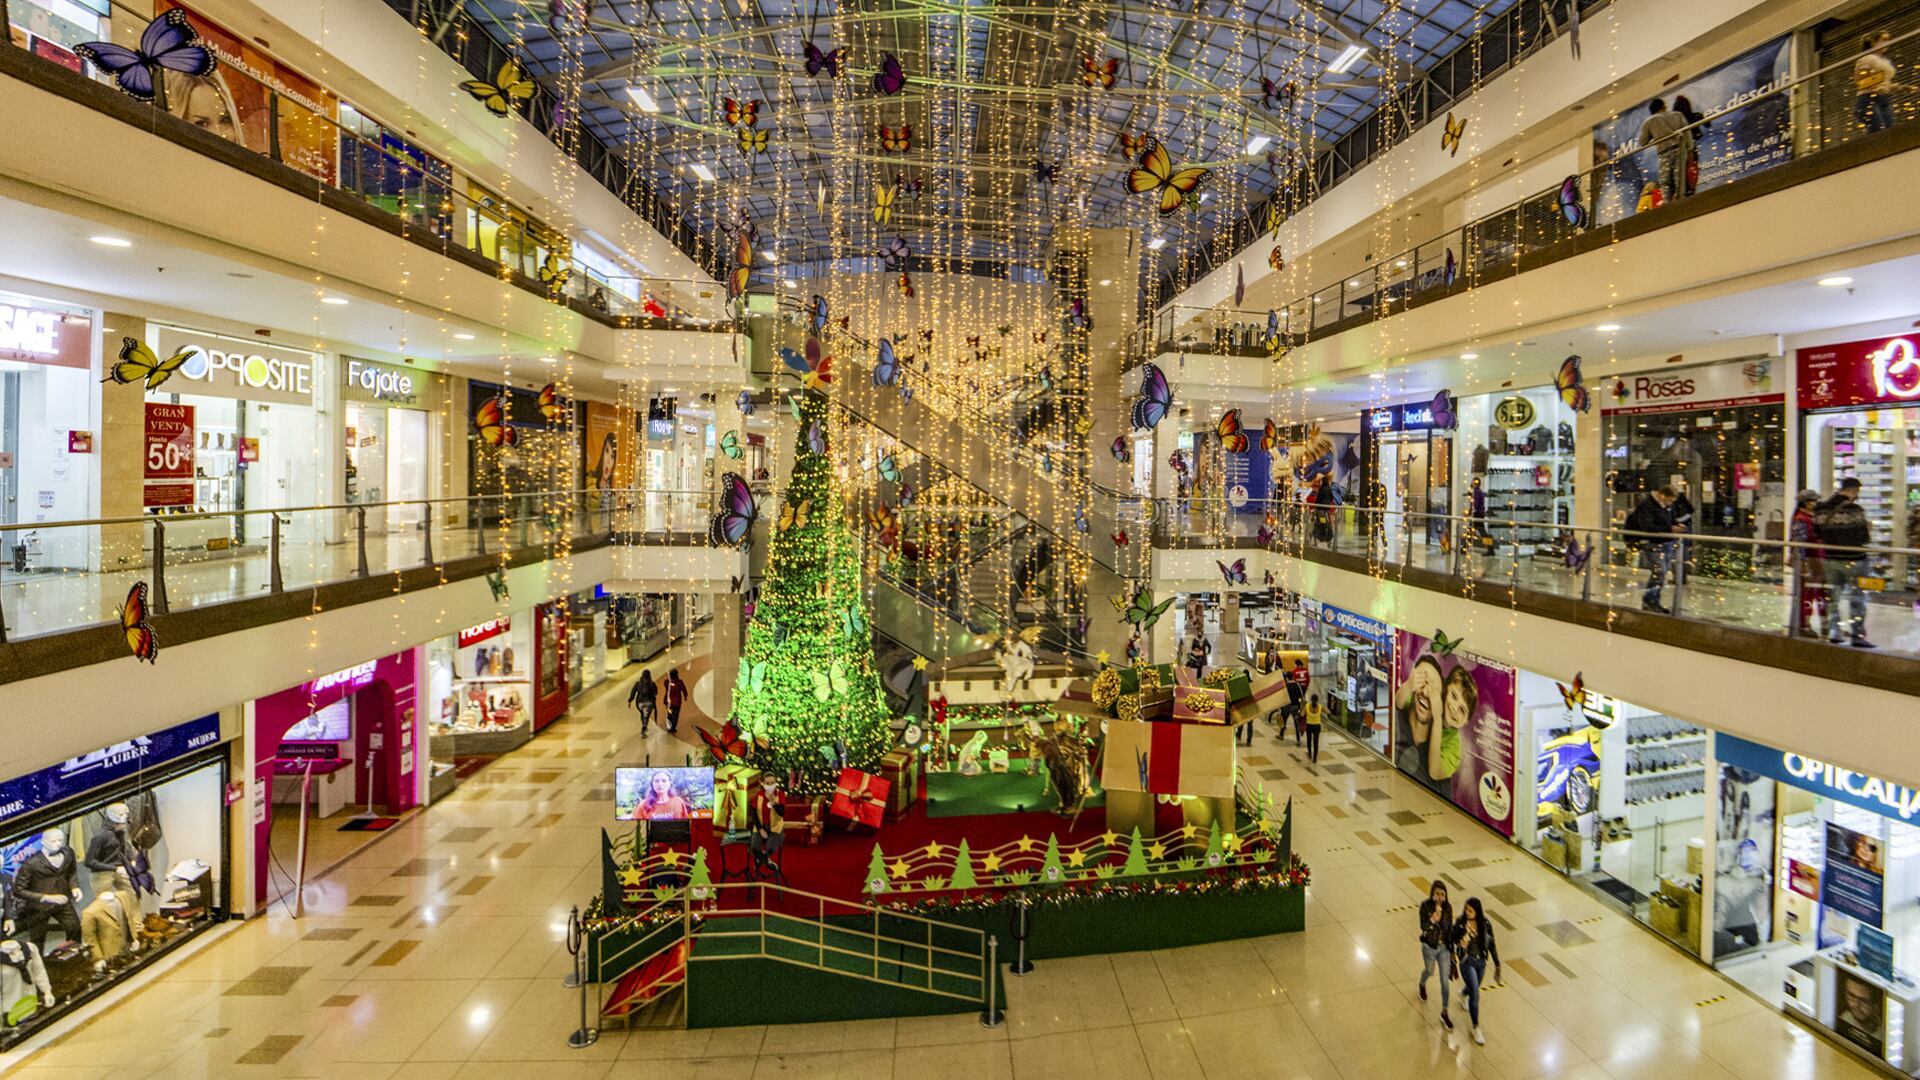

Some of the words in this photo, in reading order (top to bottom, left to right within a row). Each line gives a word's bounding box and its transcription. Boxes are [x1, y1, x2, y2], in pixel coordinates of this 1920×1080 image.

[207, 40, 248, 71] Mundo
[347, 361, 412, 398] Fajate
[1635, 376, 1696, 400] Rosas
[153, 407, 185, 418] GRAN
[150, 420, 188, 432] VENTA
[187, 731, 217, 748] MUJER
[103, 744, 150, 768] LUBER
